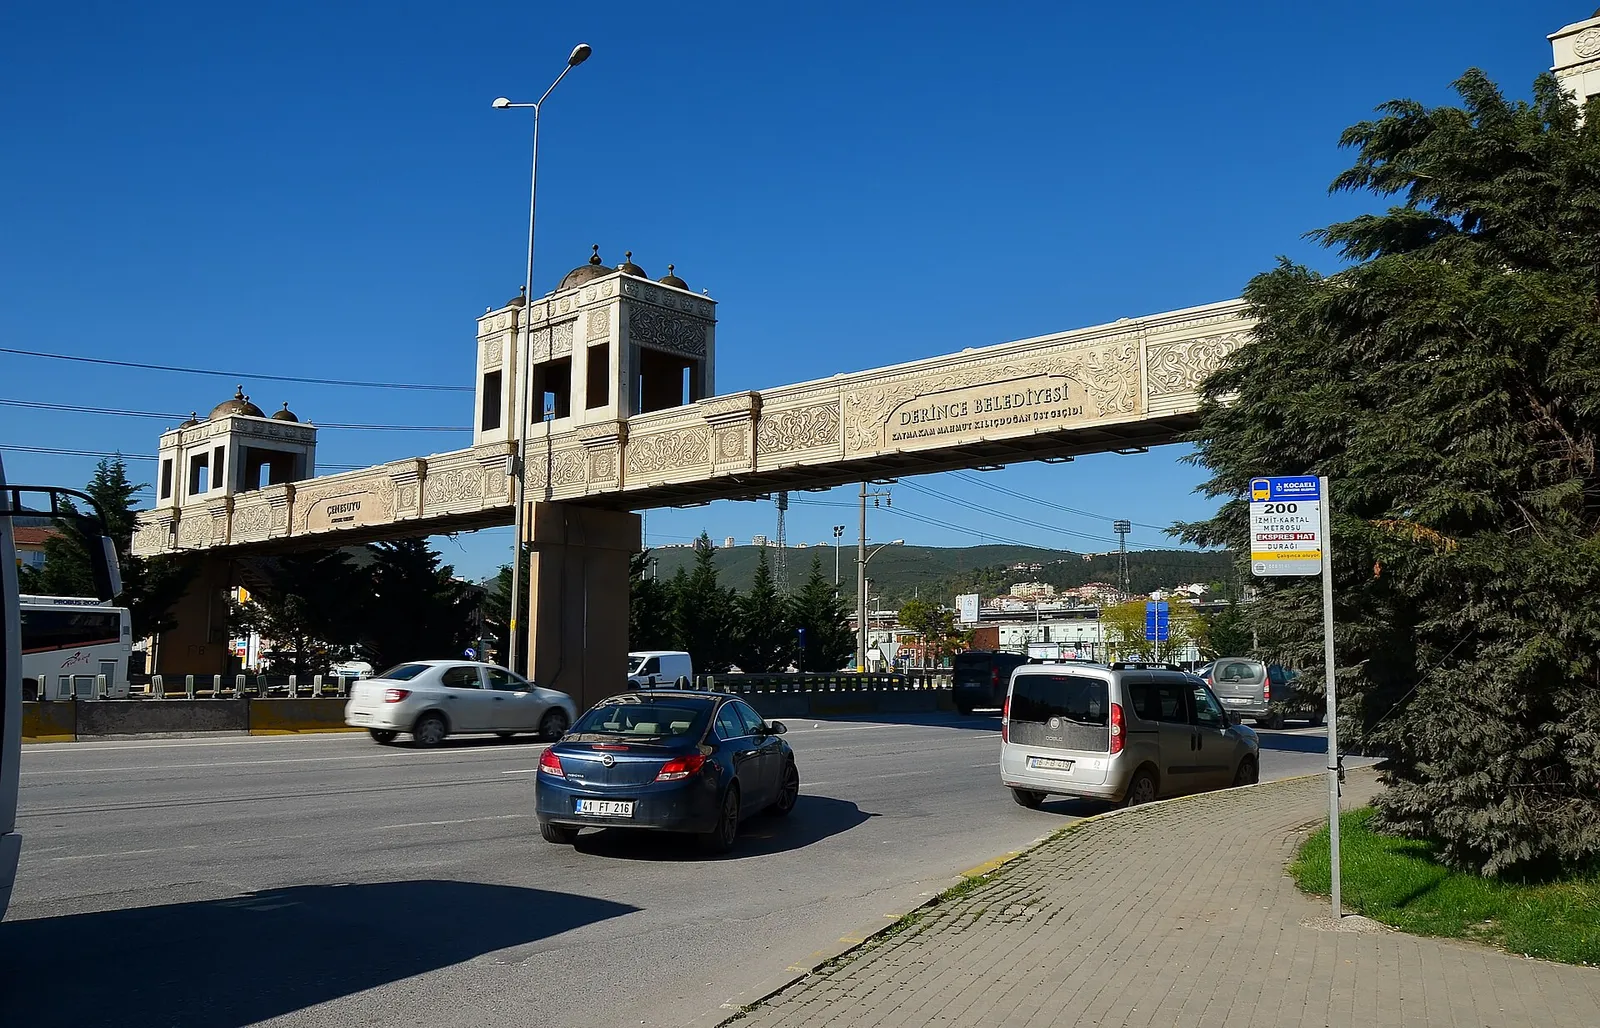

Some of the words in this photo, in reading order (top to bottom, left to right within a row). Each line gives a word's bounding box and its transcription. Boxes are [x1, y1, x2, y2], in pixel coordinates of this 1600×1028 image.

[900, 401, 968, 426] DERİNCE
[973, 382, 1069, 414] BELEDİYESİ
[937, 422, 972, 435] MAHMUT
[1264, 503, 1298, 514] 200
[1267, 542, 1298, 550] DURAĞI
[583, 801, 593, 812] 41
[599, 802, 610, 812] FT
[614, 803, 630, 814] 216
